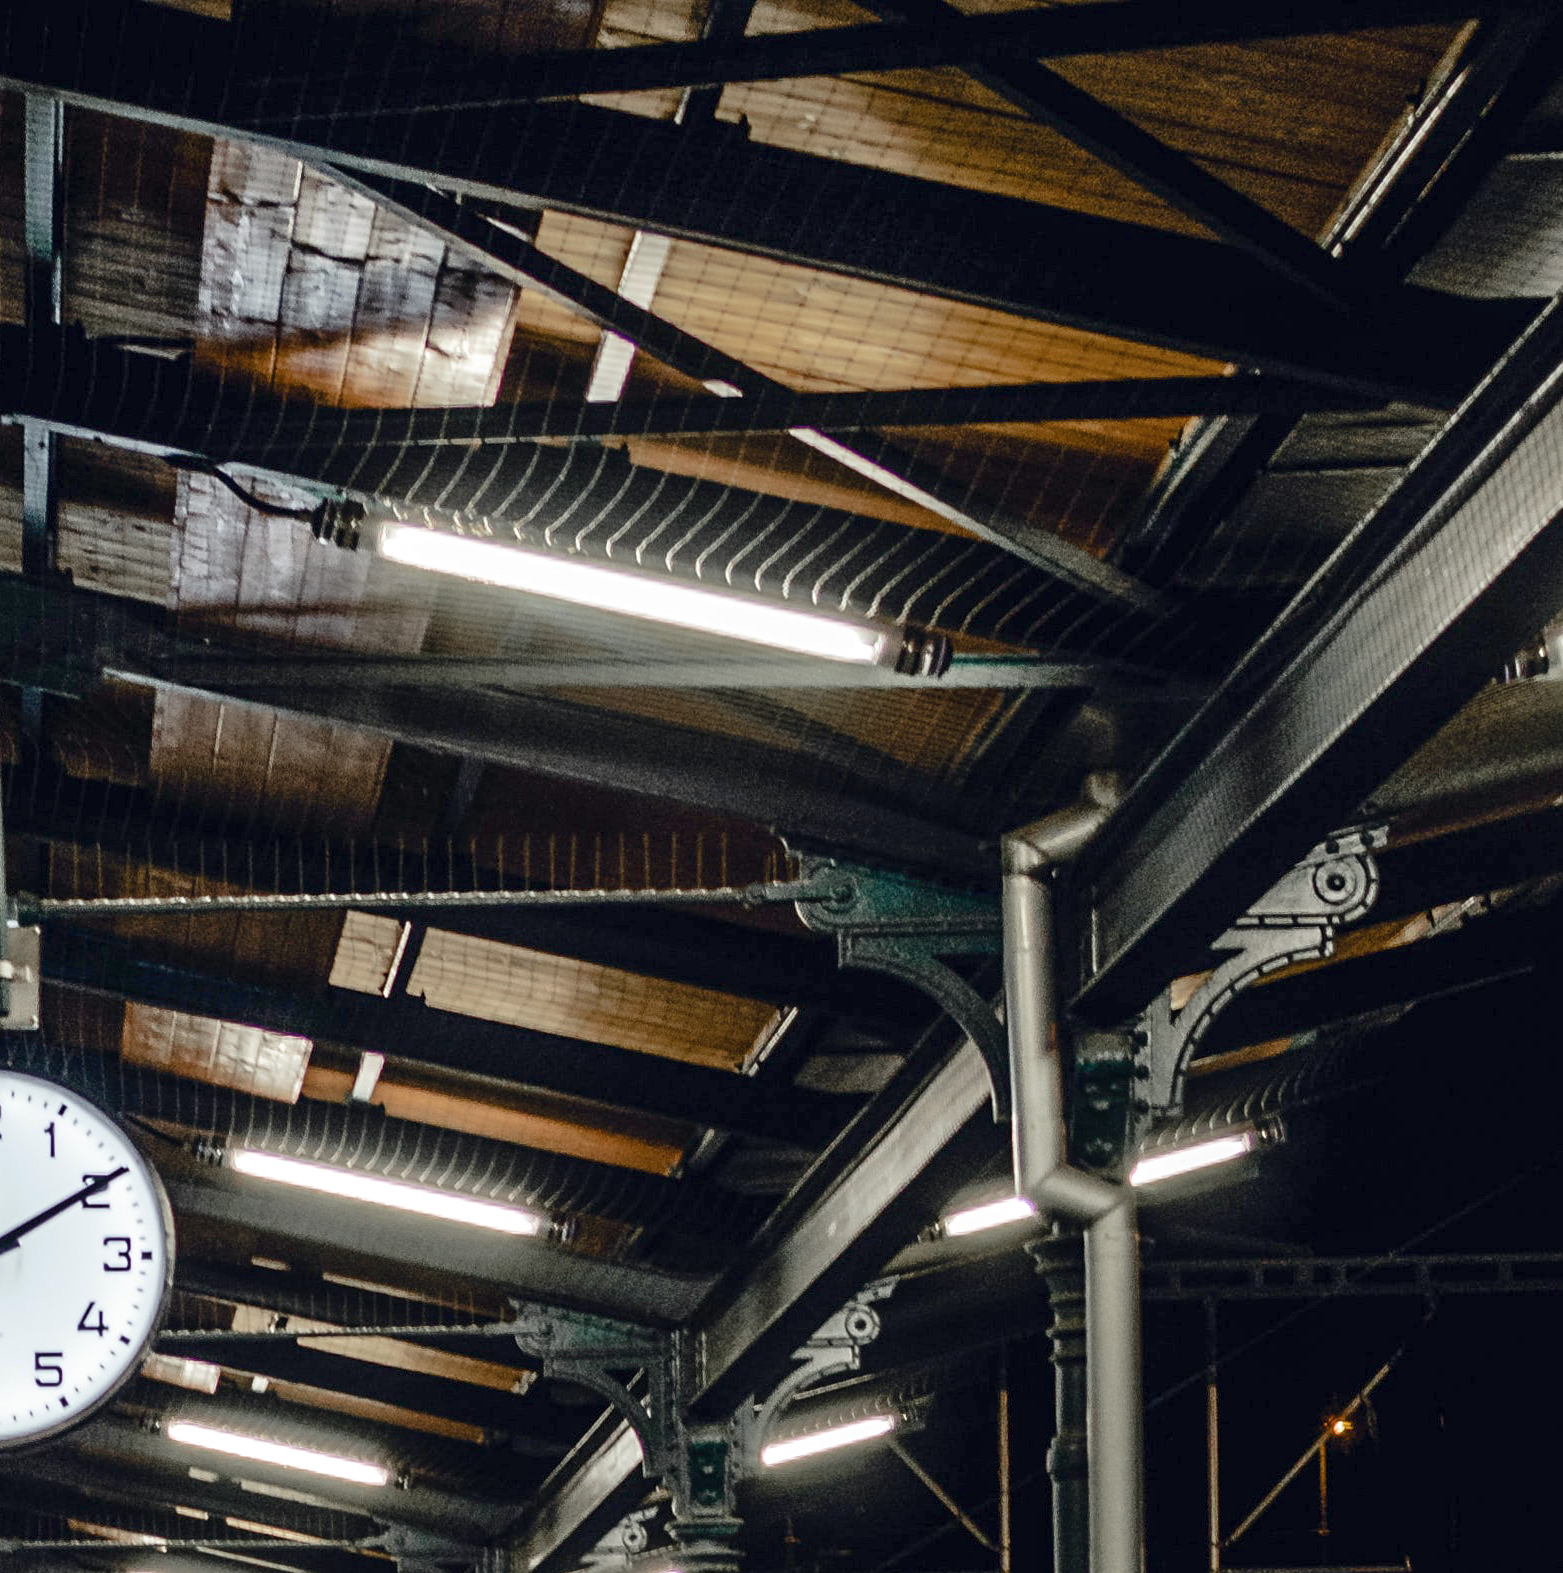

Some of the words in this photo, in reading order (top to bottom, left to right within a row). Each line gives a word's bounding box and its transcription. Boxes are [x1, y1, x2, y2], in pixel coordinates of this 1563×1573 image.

[44, 1122, 56, 1158] 1
[103, 1237, 131, 1272] 3
[77, 1302, 109, 1337] 4
[35, 1352, 63, 1387] 5
